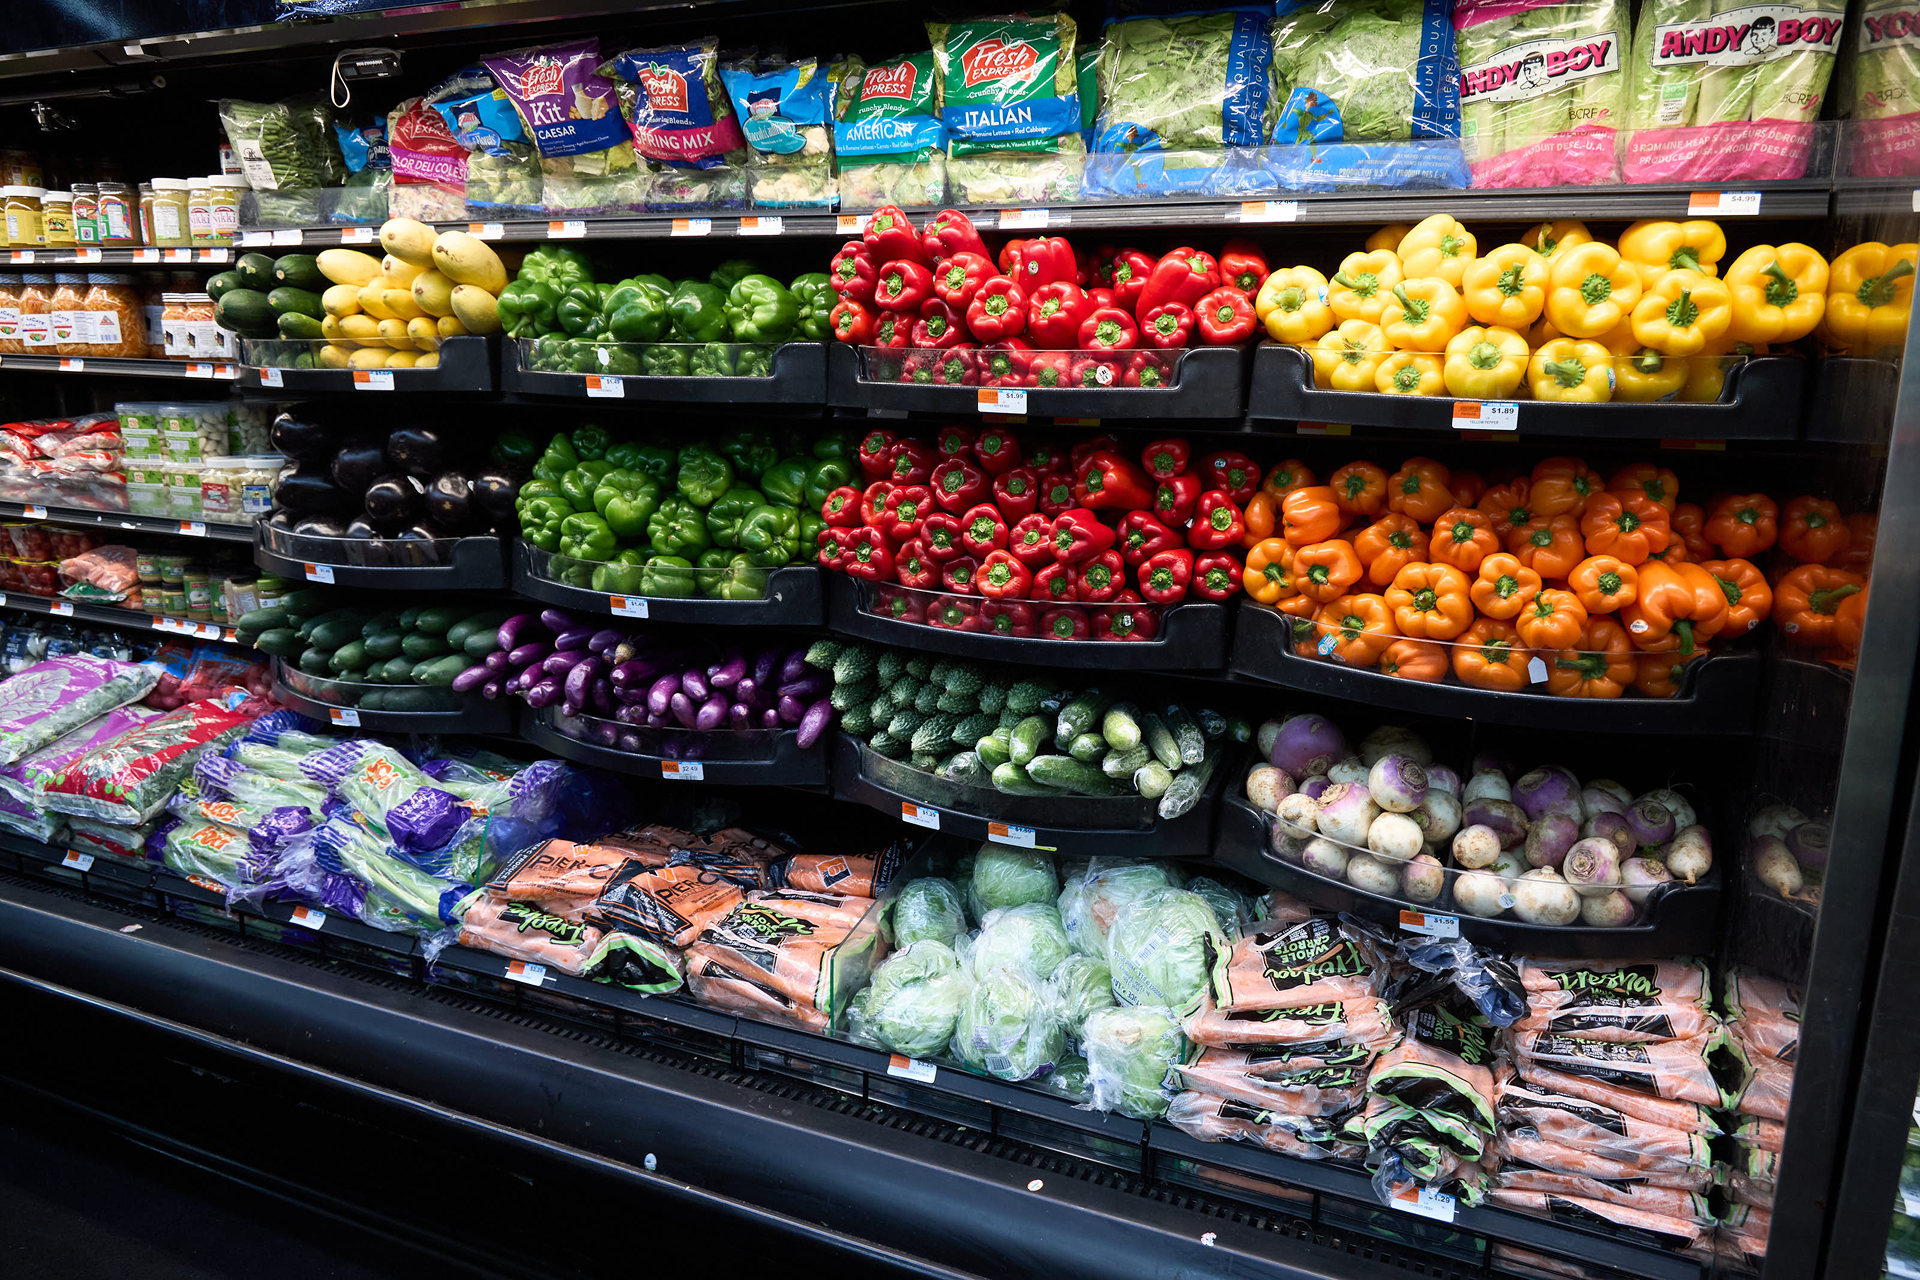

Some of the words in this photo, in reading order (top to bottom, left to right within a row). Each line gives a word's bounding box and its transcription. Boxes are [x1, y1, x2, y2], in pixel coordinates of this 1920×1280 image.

[1660, 24, 1751, 59] ANDY
[1777, 16, 1842, 47] BOY
[973, 44, 1029, 68] Fresh
[1547, 40, 1612, 78] BOY
[528, 62, 557, 87] Fresh
[866, 62, 908, 85] Fresh
[972, 65, 1026, 80] EXPRESS
[530, 101, 566, 126] Kit
[965, 107, 1032, 128] ITALIAN
[1569, 107, 1598, 120] BCRF
[538, 125, 577, 140] CAESAR
[635, 131, 681, 149] SPRING
[683, 131, 714, 149] MIX
[415, 160, 435, 172] DELI
[1639, 153, 1684, 165] PRODUCE
[1339, 168, 1363, 177] PRODUCT
[843, 217, 857, 225] WIC
[1491, 407, 1515, 415] $1.89
[664, 763, 677, 771] WIC
[529, 855, 614, 880] PIER-C
[1274, 935, 1330, 955] CARROTS
[1281, 944, 1330, 964] WHOLE
[1551, 967, 1663, 996] Fresha
